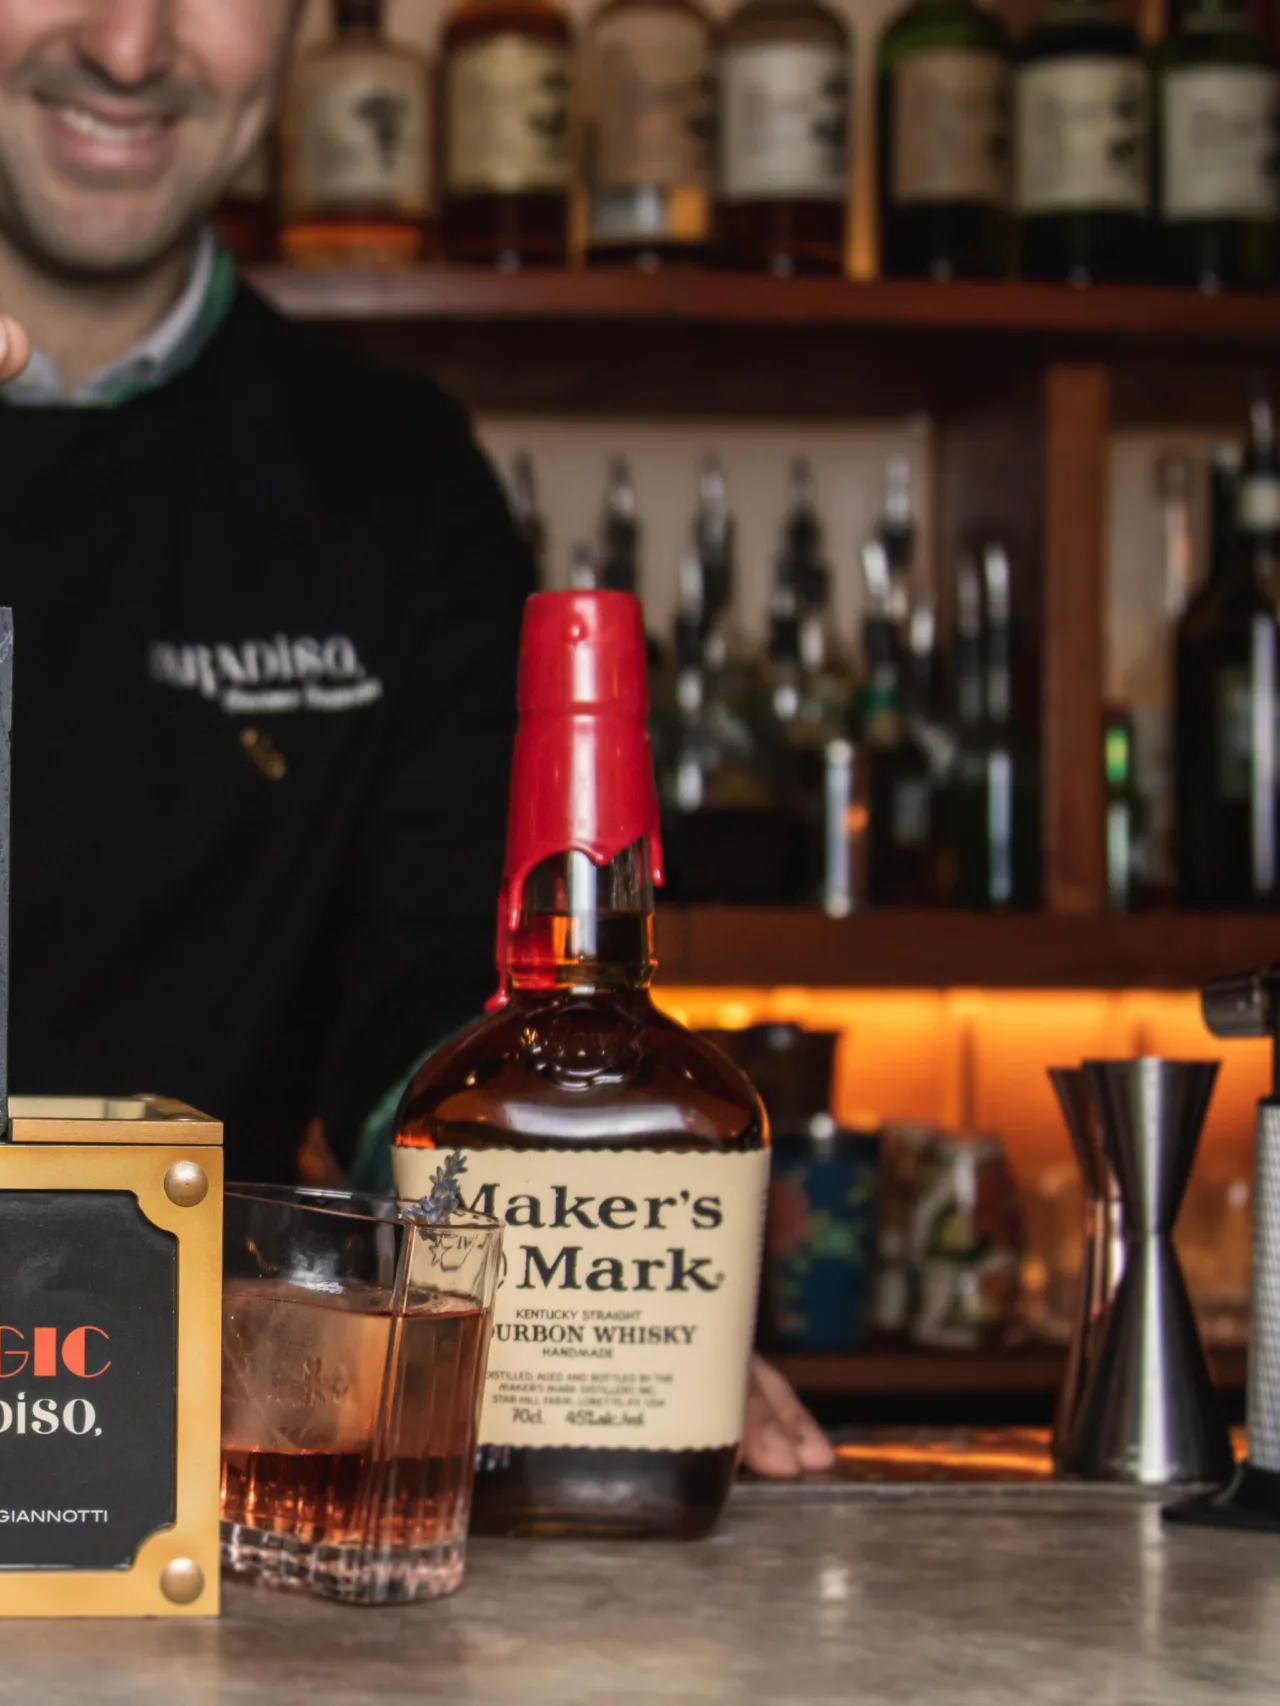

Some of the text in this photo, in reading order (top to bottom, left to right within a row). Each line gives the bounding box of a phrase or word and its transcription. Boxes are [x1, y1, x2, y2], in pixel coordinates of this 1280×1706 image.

[515, 1244, 726, 1292] Mark
[516, 1309, 642, 1322] KENTUCKY STRAIGHT
[593, 1325, 697, 1345] WHISKY
[542, 1347, 614, 1359] HANDMADE
